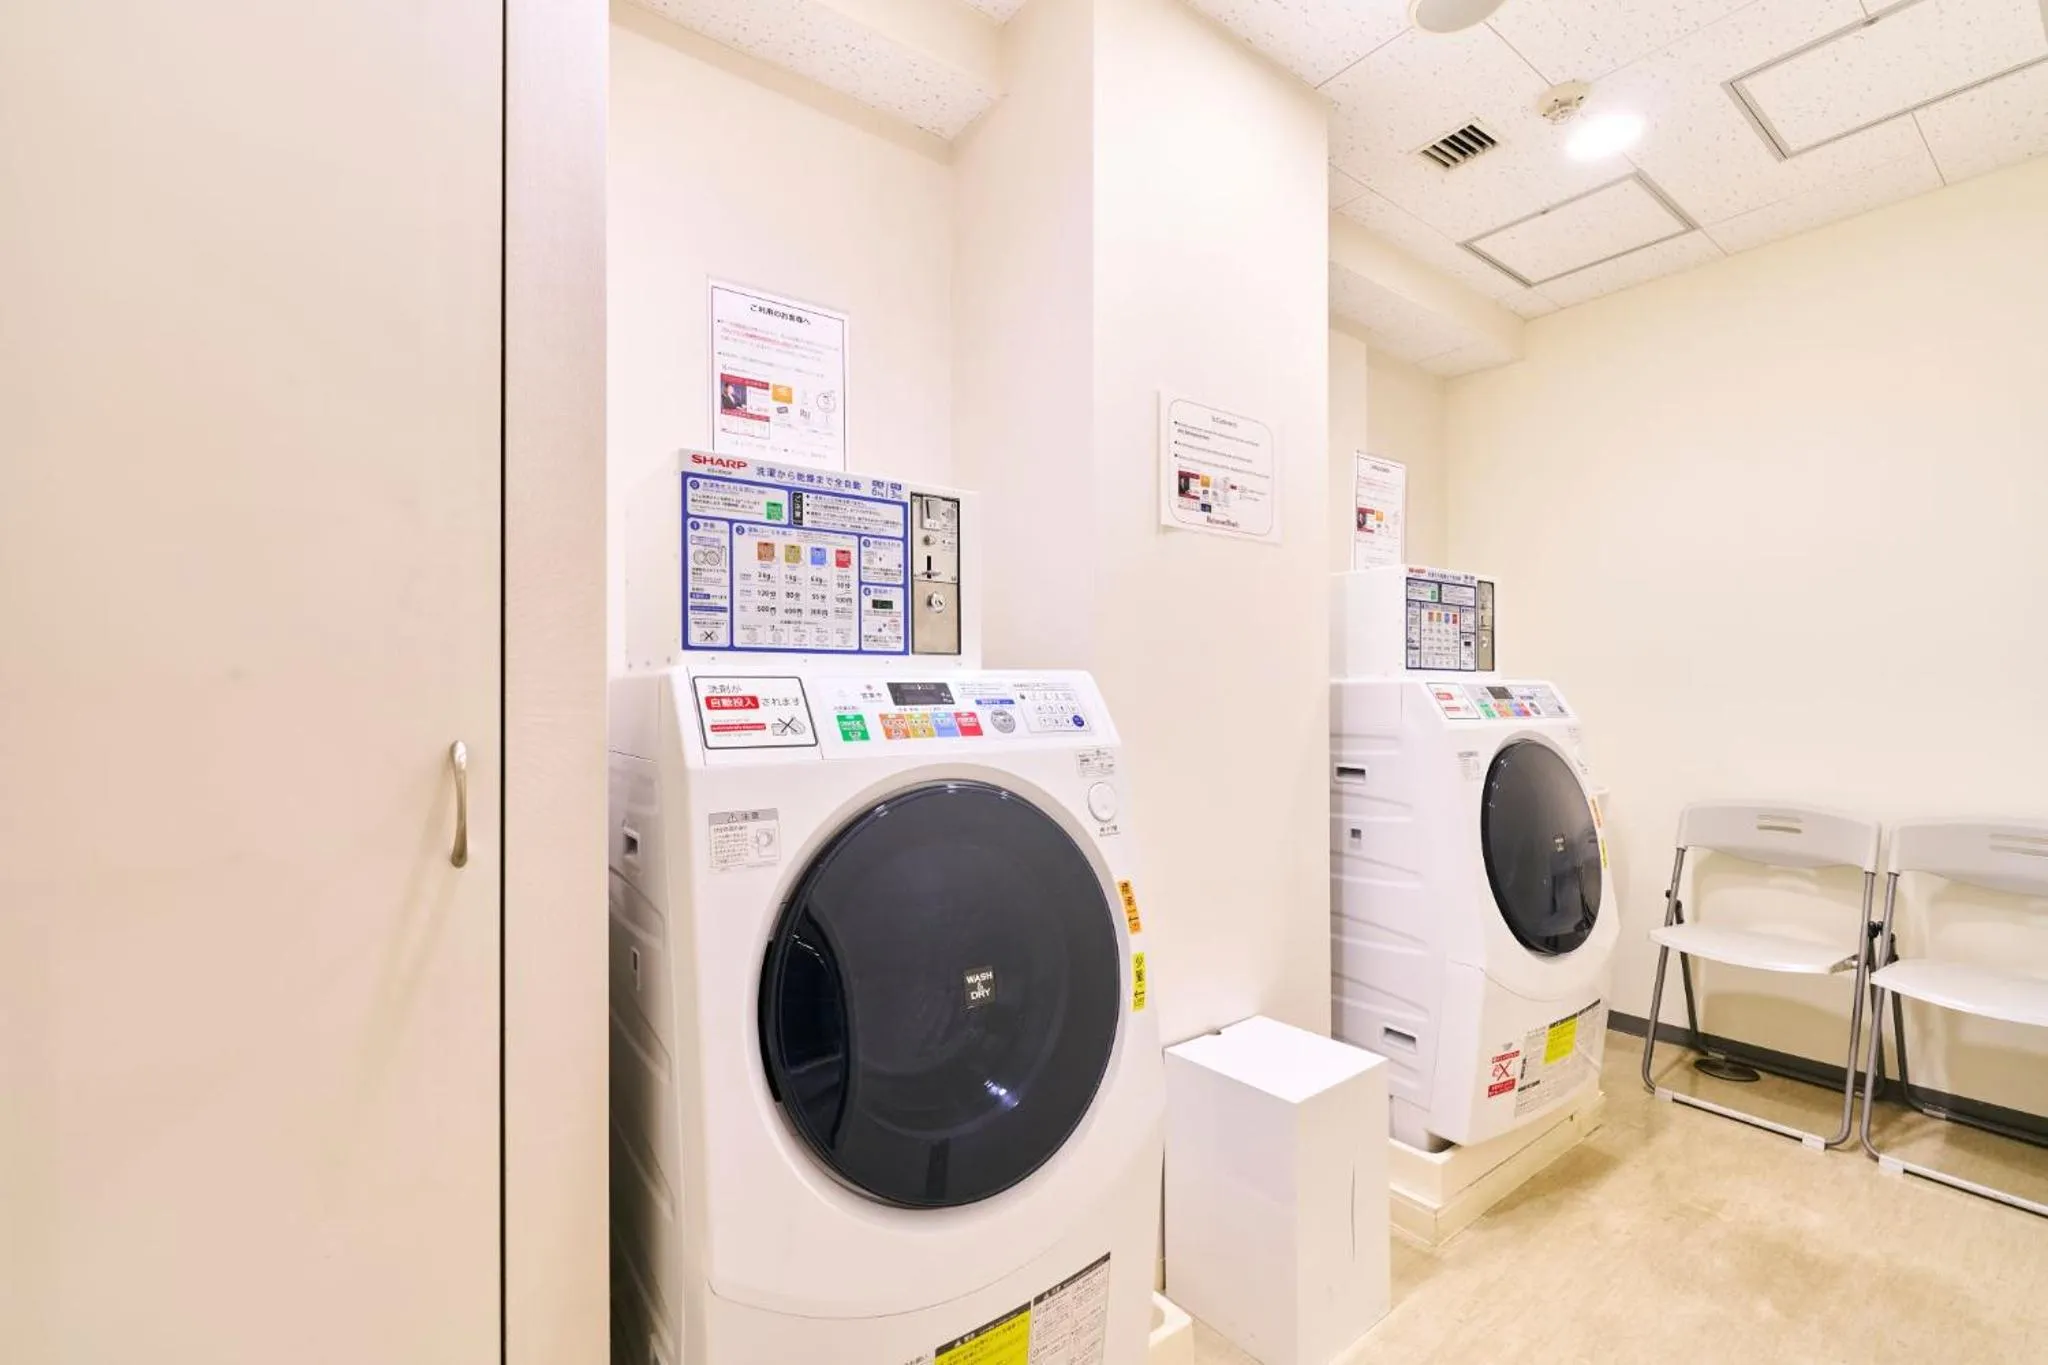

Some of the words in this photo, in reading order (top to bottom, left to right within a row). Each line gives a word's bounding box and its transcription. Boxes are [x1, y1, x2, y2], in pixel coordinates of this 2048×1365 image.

[750, 304, 811, 325] ご利用のお客様へ
[691, 454, 748, 469] SHARP
[756, 466, 862, 491] 洗濯から乾燥まで全自動
[708, 684, 742, 694] 洗剤が
[710, 698, 755, 707] 自動投入
[762, 698, 800, 706] されます
[966, 971, 992, 984] WASH
[970, 987, 991, 1000] DRY
